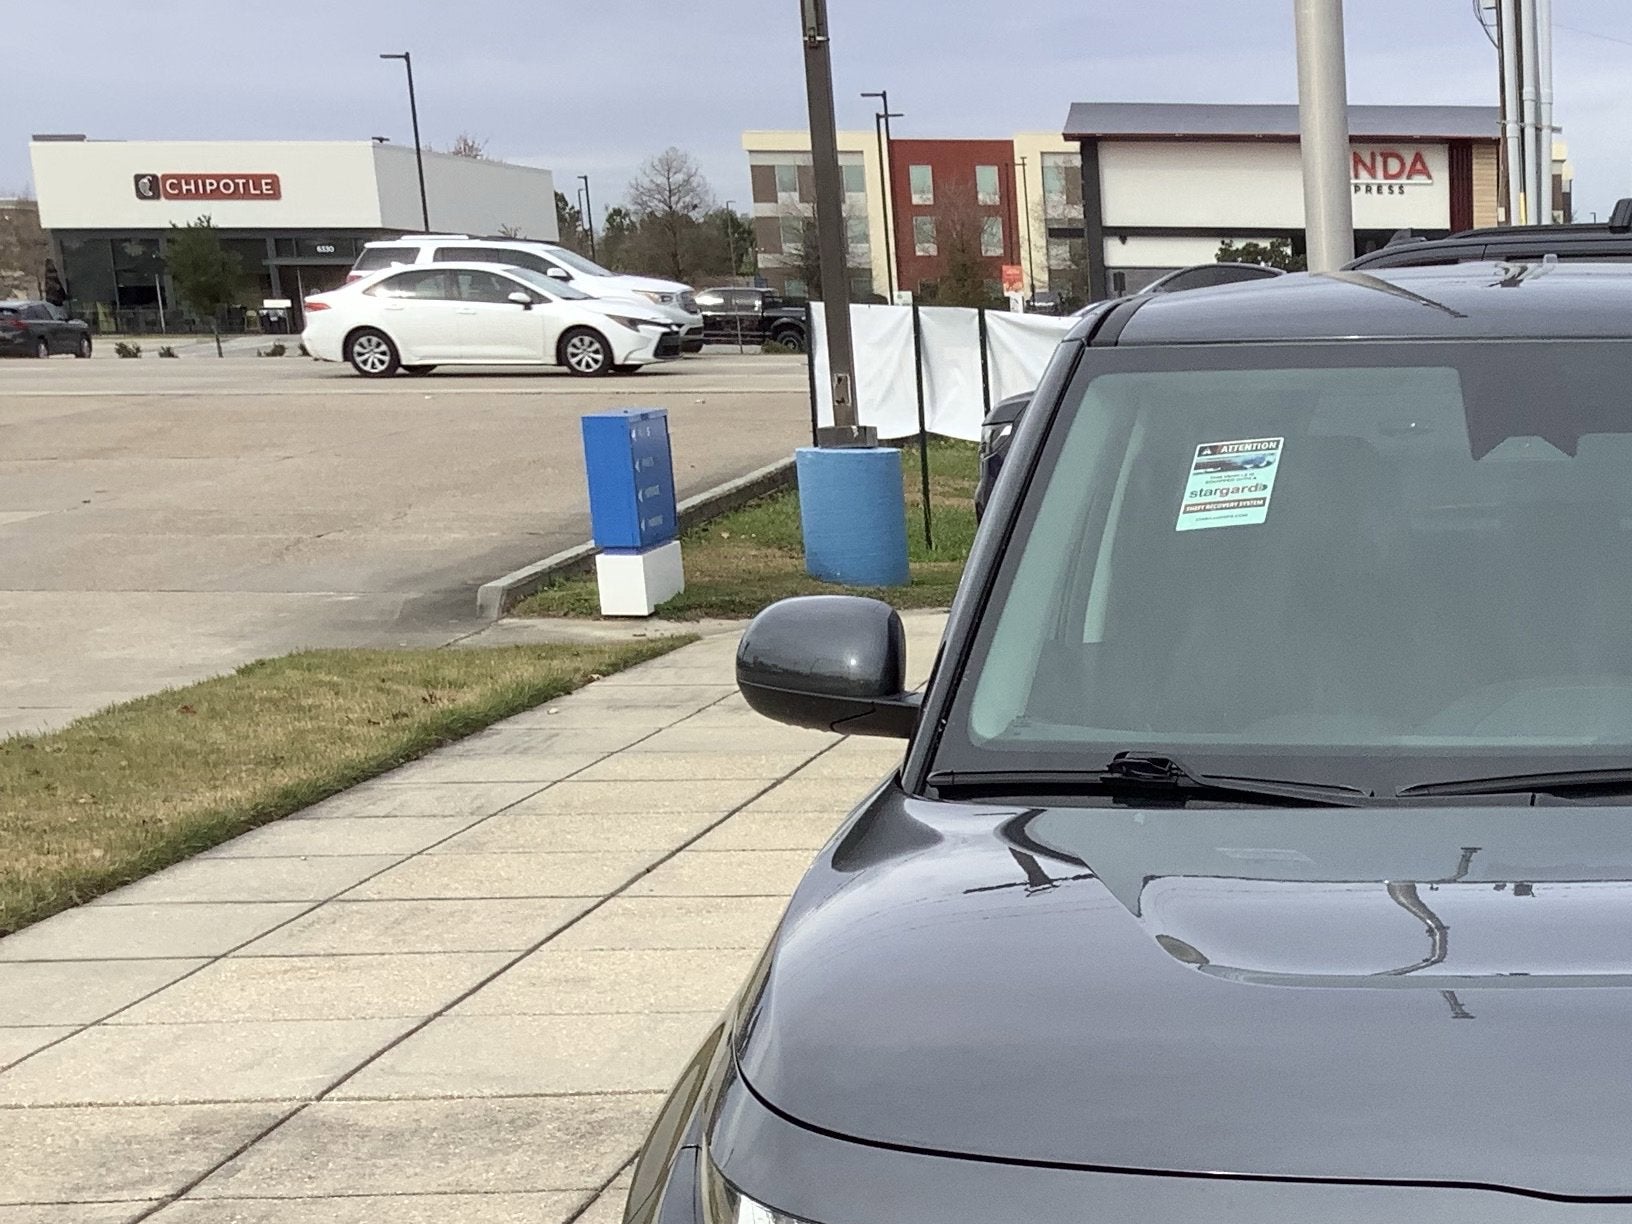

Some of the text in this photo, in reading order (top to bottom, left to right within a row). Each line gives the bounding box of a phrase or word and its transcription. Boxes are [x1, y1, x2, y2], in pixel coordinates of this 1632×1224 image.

[1352, 151, 1433, 180] NDA
[165, 178, 275, 195] CHIPOTLE
[1354, 184, 1406, 195] PRESS
[1220, 441, 1278, 453] ATTENTION
